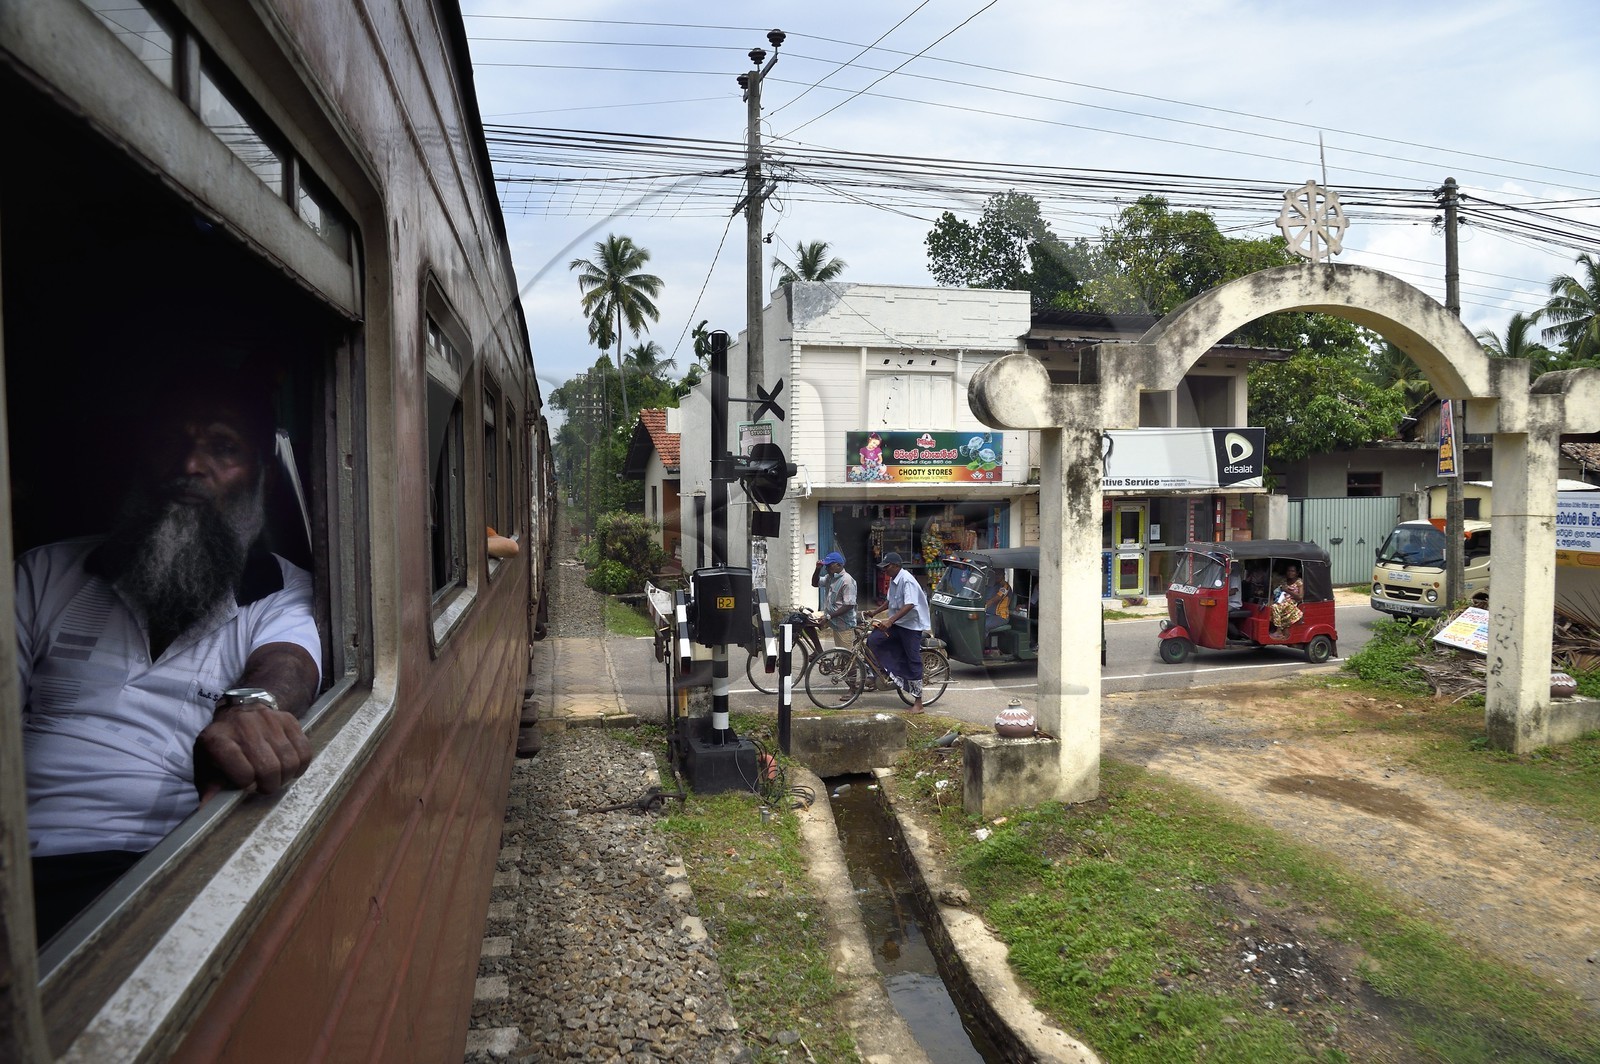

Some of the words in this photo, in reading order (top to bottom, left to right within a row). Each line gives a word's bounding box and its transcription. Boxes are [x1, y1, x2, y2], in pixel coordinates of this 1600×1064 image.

[1224, 465, 1253, 474] etisalat
[1125, 478, 1160, 486] Service
[718, 598, 732, 608] B2
